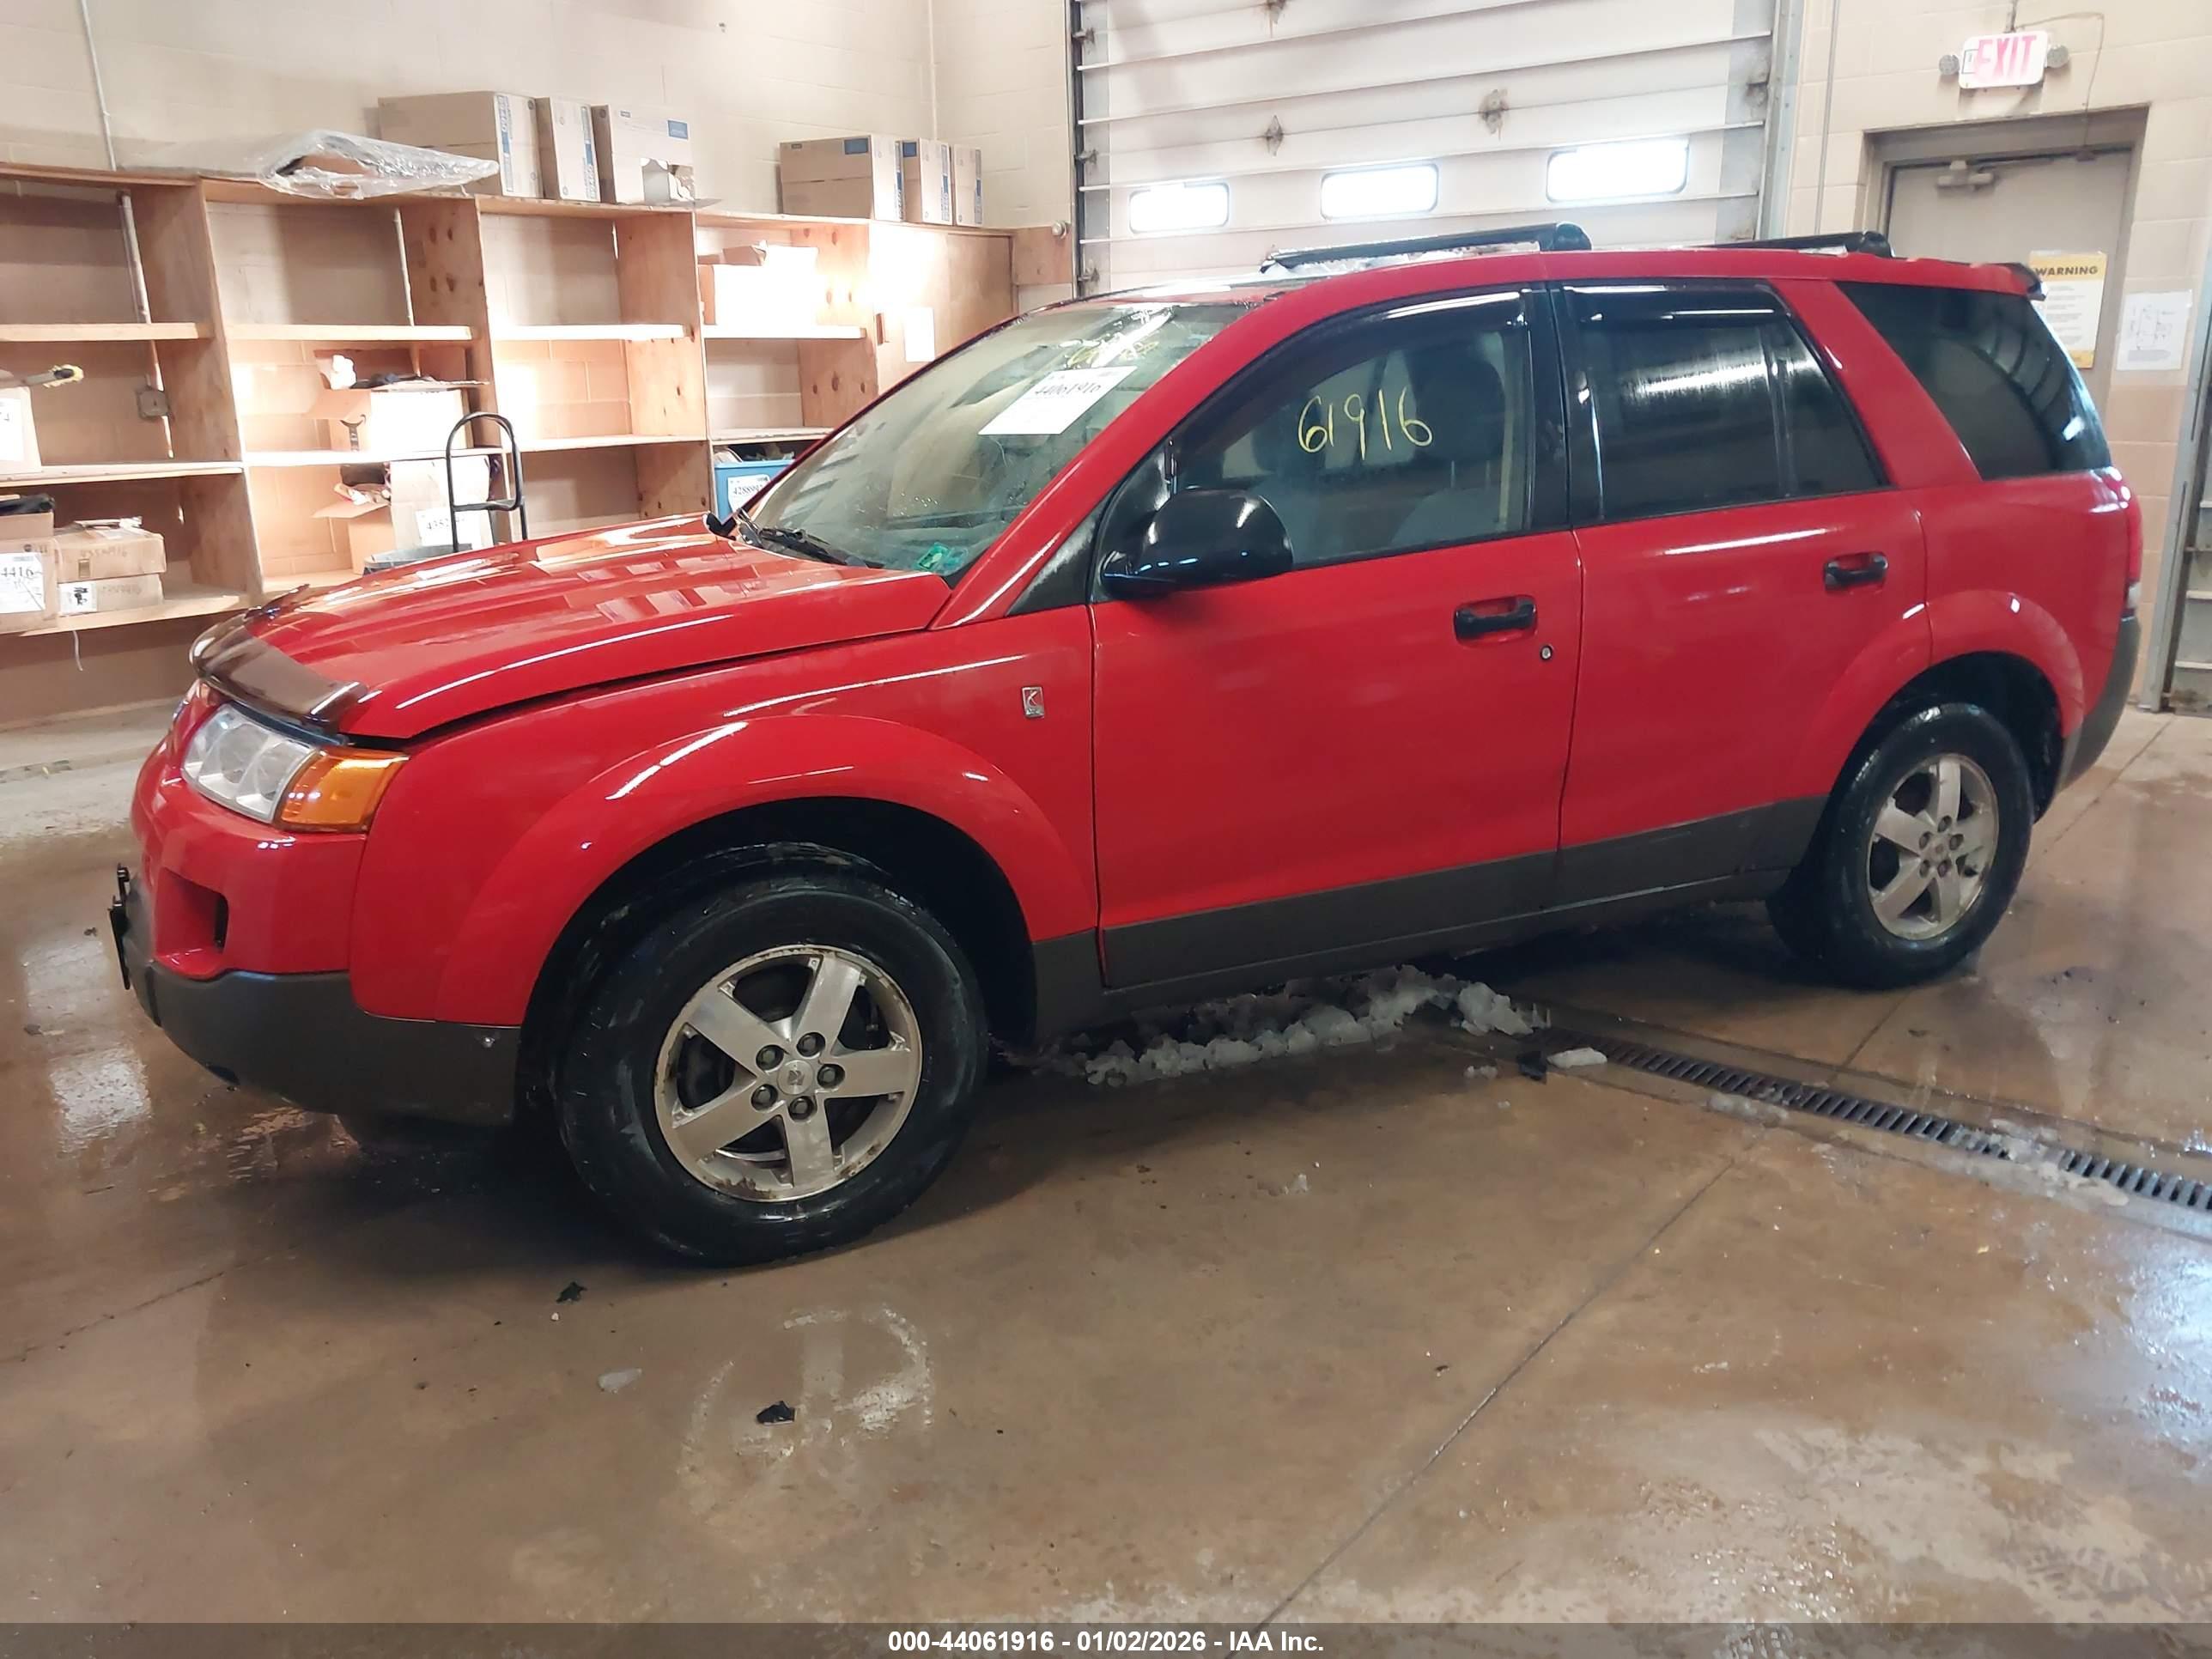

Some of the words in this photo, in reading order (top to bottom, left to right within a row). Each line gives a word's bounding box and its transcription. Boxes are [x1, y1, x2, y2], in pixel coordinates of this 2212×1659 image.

[1974, 35, 2038, 82] EXIT
[2035, 265, 2099, 276] WARNING
[1297, 386, 1433, 460] 61916
